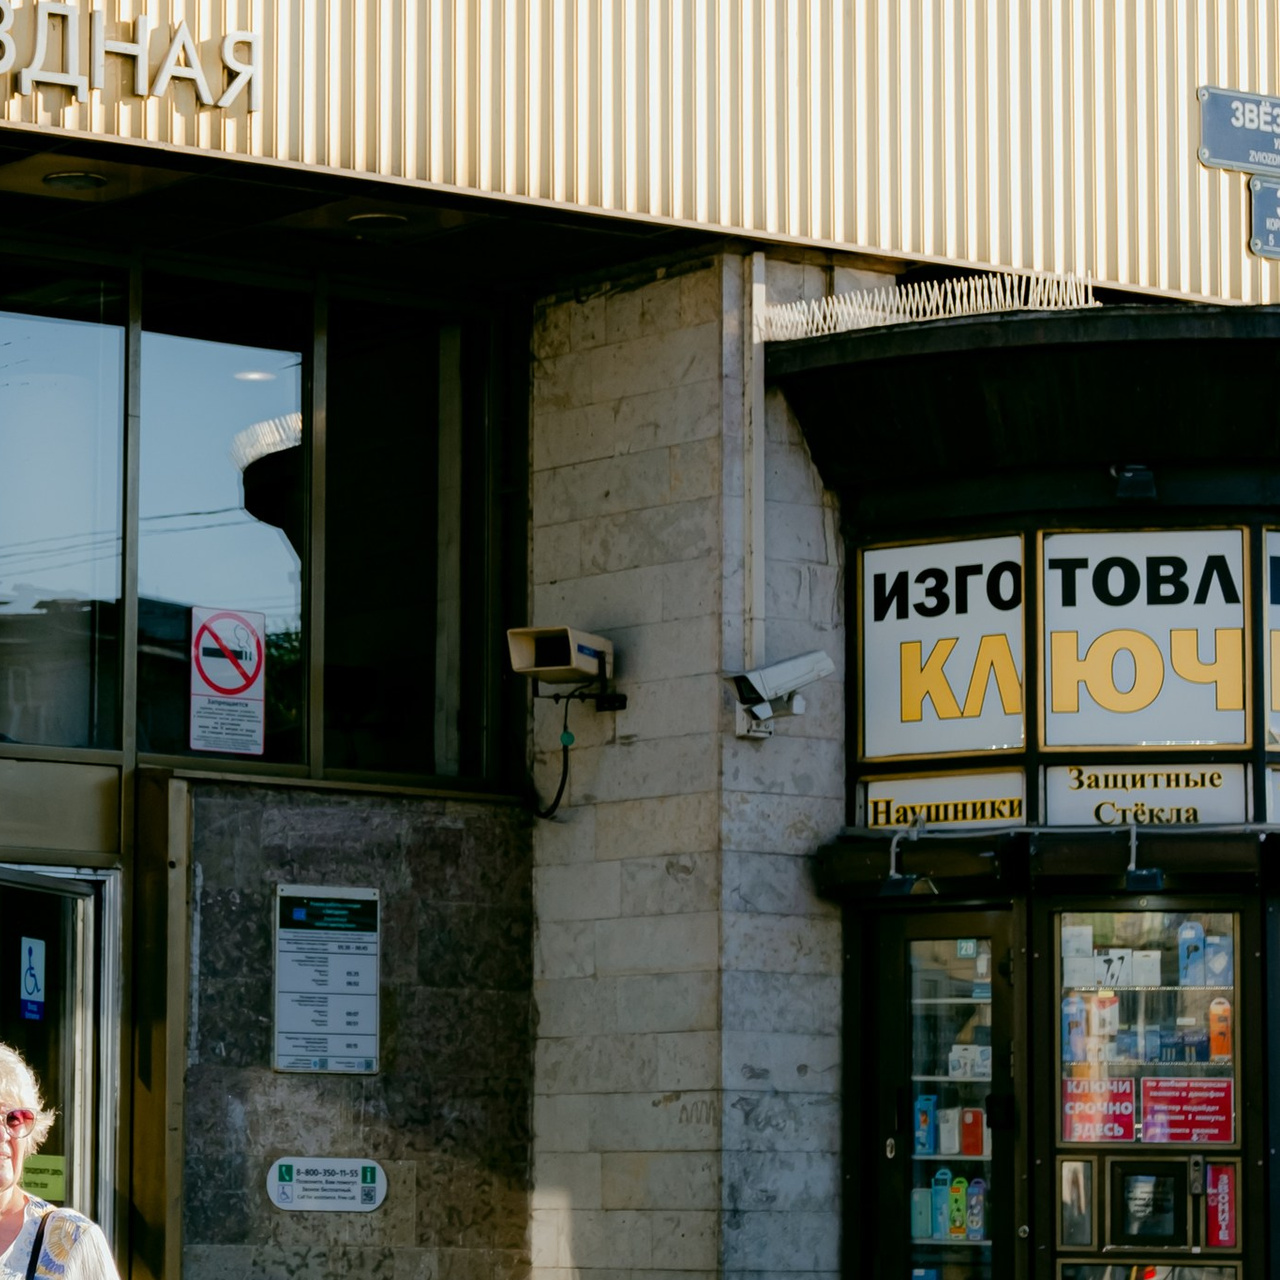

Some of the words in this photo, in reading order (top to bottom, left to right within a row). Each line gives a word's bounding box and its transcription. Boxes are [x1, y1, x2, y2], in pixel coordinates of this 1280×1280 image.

[1067, 766, 1223, 793] Защитные
[870, 798, 1023, 828] Наушники
[1094, 801, 1199, 825] Стёкла
[960, 942, 974, 955] 20
[1066, 1081, 1131, 1094] КЛЮЧИ
[1064, 1101, 1133, 1115] СРОЧНО
[1073, 1122, 1124, 1139] ЗДЕСЬ
[296, 1168, 359, 1178] 8-800-350-11-55
